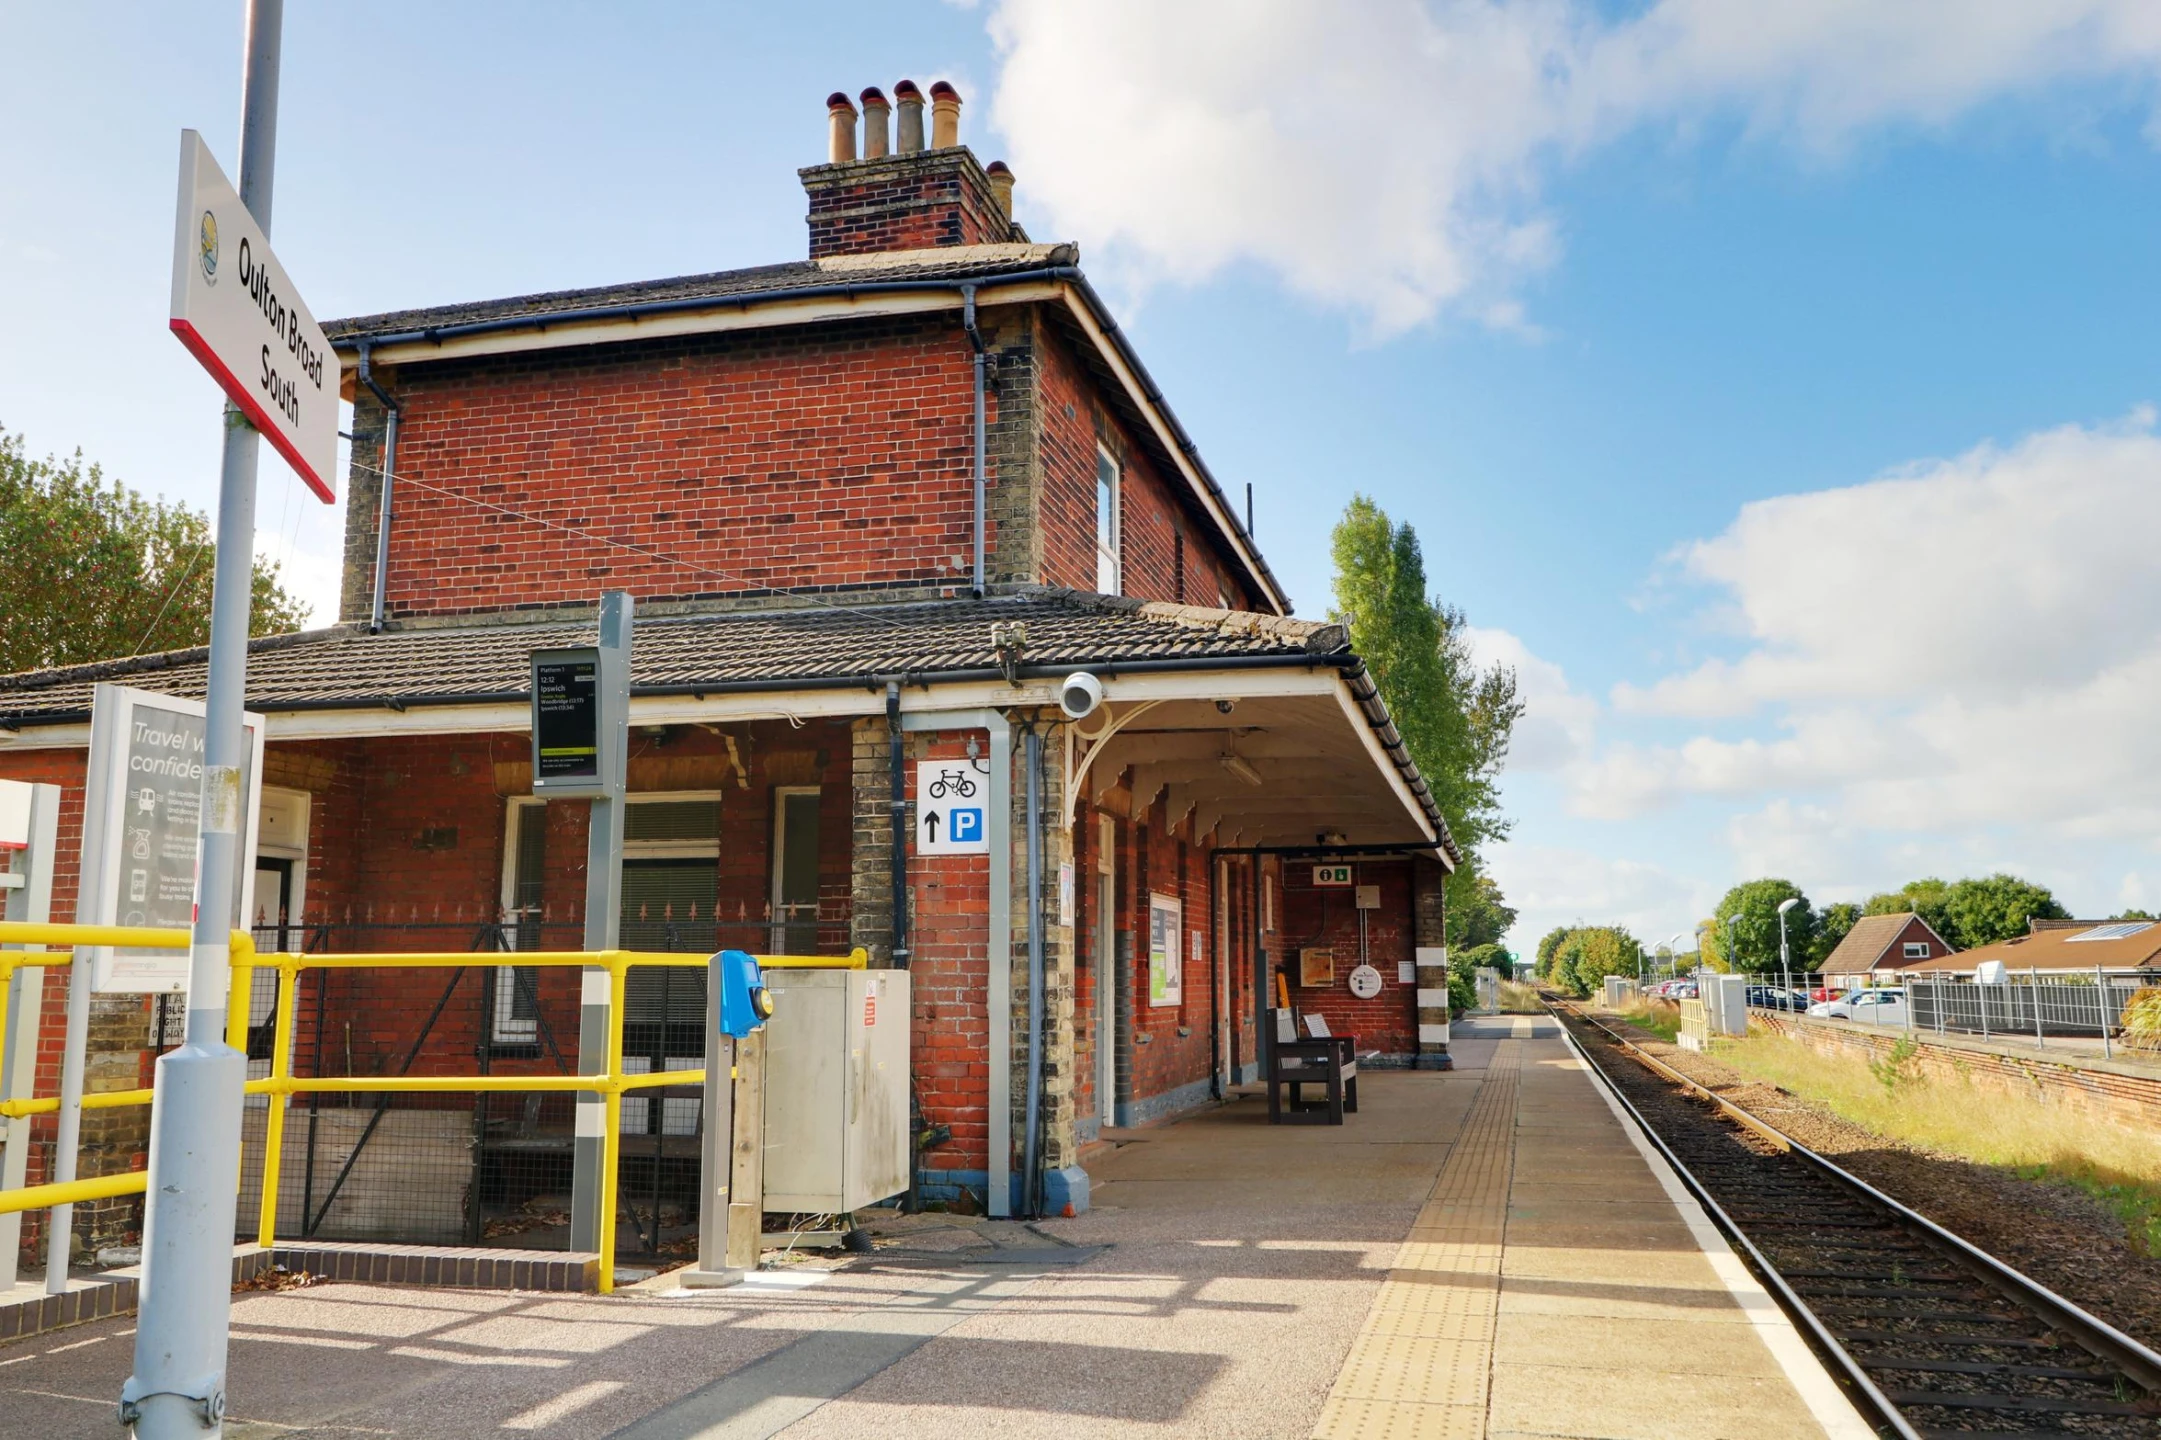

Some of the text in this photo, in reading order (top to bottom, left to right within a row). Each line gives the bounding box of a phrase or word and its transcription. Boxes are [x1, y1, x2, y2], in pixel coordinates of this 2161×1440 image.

[239, 236, 323, 392] Oulton Broad
[260, 343, 299, 428] South
[541, 684, 566, 693] Ipswich
[135, 721, 190, 750] Travel
[956, 812, 976, 839] P
[156, 994, 172, 1003] NT
[164, 1028, 184, 1038] WAY
